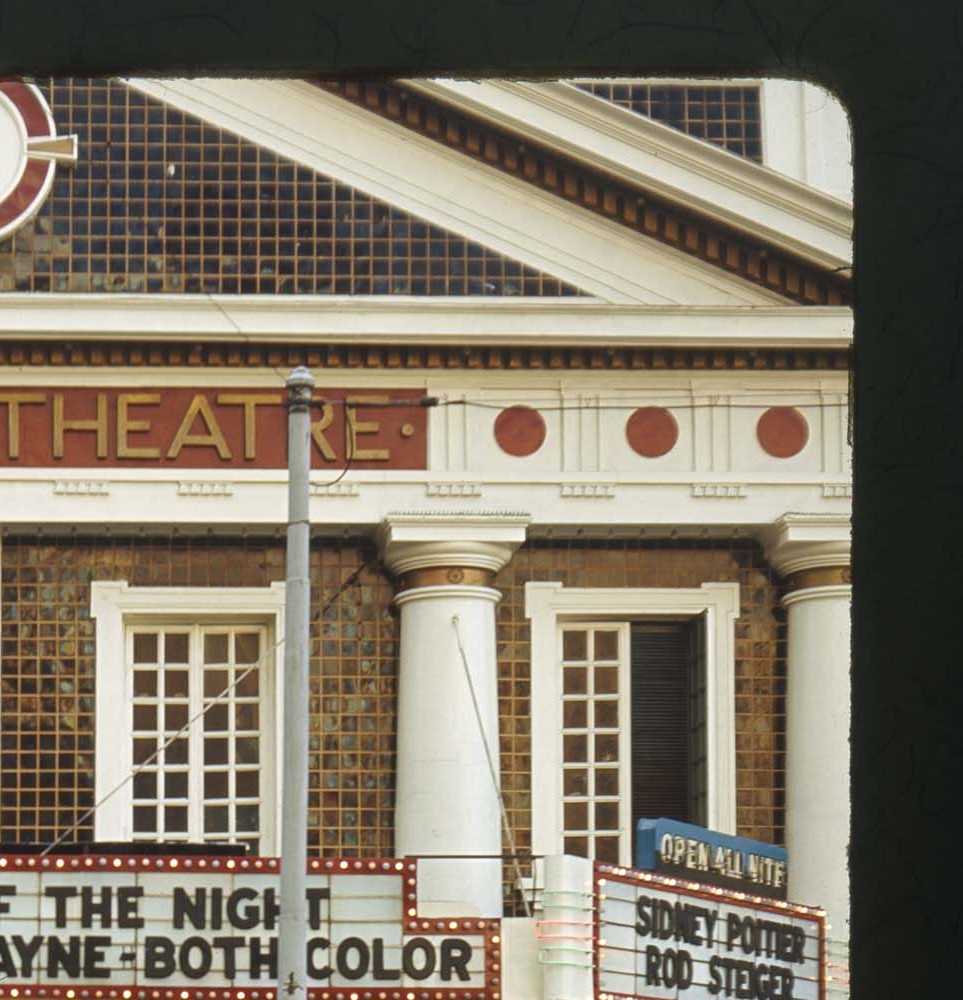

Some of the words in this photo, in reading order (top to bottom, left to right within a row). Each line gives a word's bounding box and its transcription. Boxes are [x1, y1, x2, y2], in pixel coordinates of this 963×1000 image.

[661, 833, 711, 871] OPEN
[714, 846, 744, 879] ALL
[748, 853, 785, 888] NITE
[45, 886, 145, 929] THE
[173, 887, 331, 931] NIGHT
[636, 895, 718, 949] SIDNEY
[305, 936, 472, 982] COLOR
[646, 944, 694, 991] ROD
